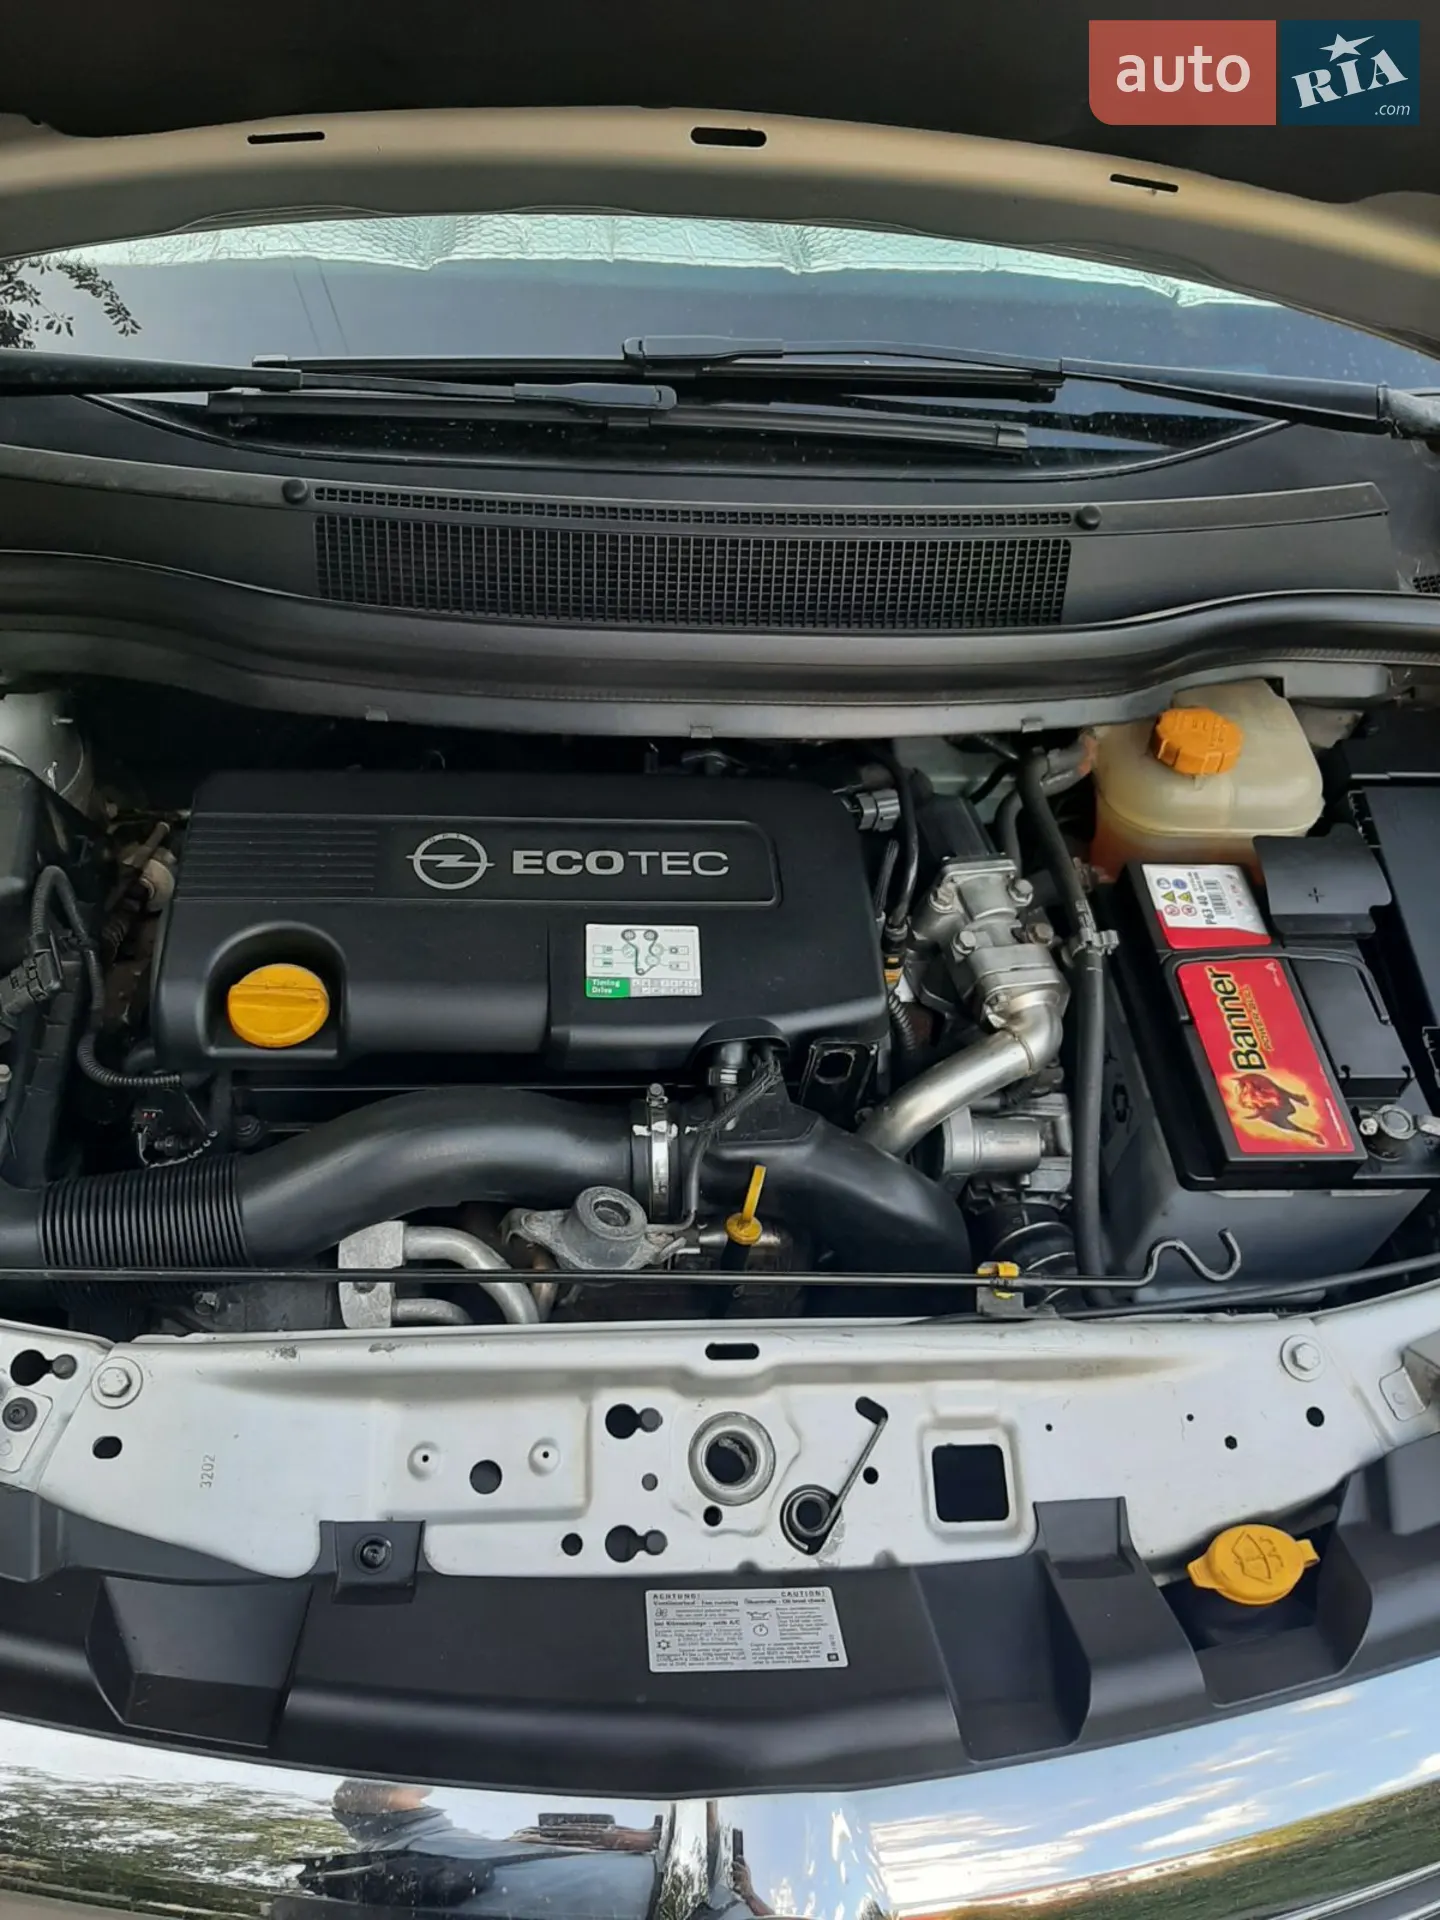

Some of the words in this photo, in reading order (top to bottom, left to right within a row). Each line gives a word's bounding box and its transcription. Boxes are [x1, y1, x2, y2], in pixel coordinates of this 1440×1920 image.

[512, 850, 729, 876] ECOTEC
[591, 979, 620, 988] Timing
[591, 986, 613, 994] Drive
[1206, 966, 1268, 1070] Banner
[200, 1454, 215, 1488] 3202
